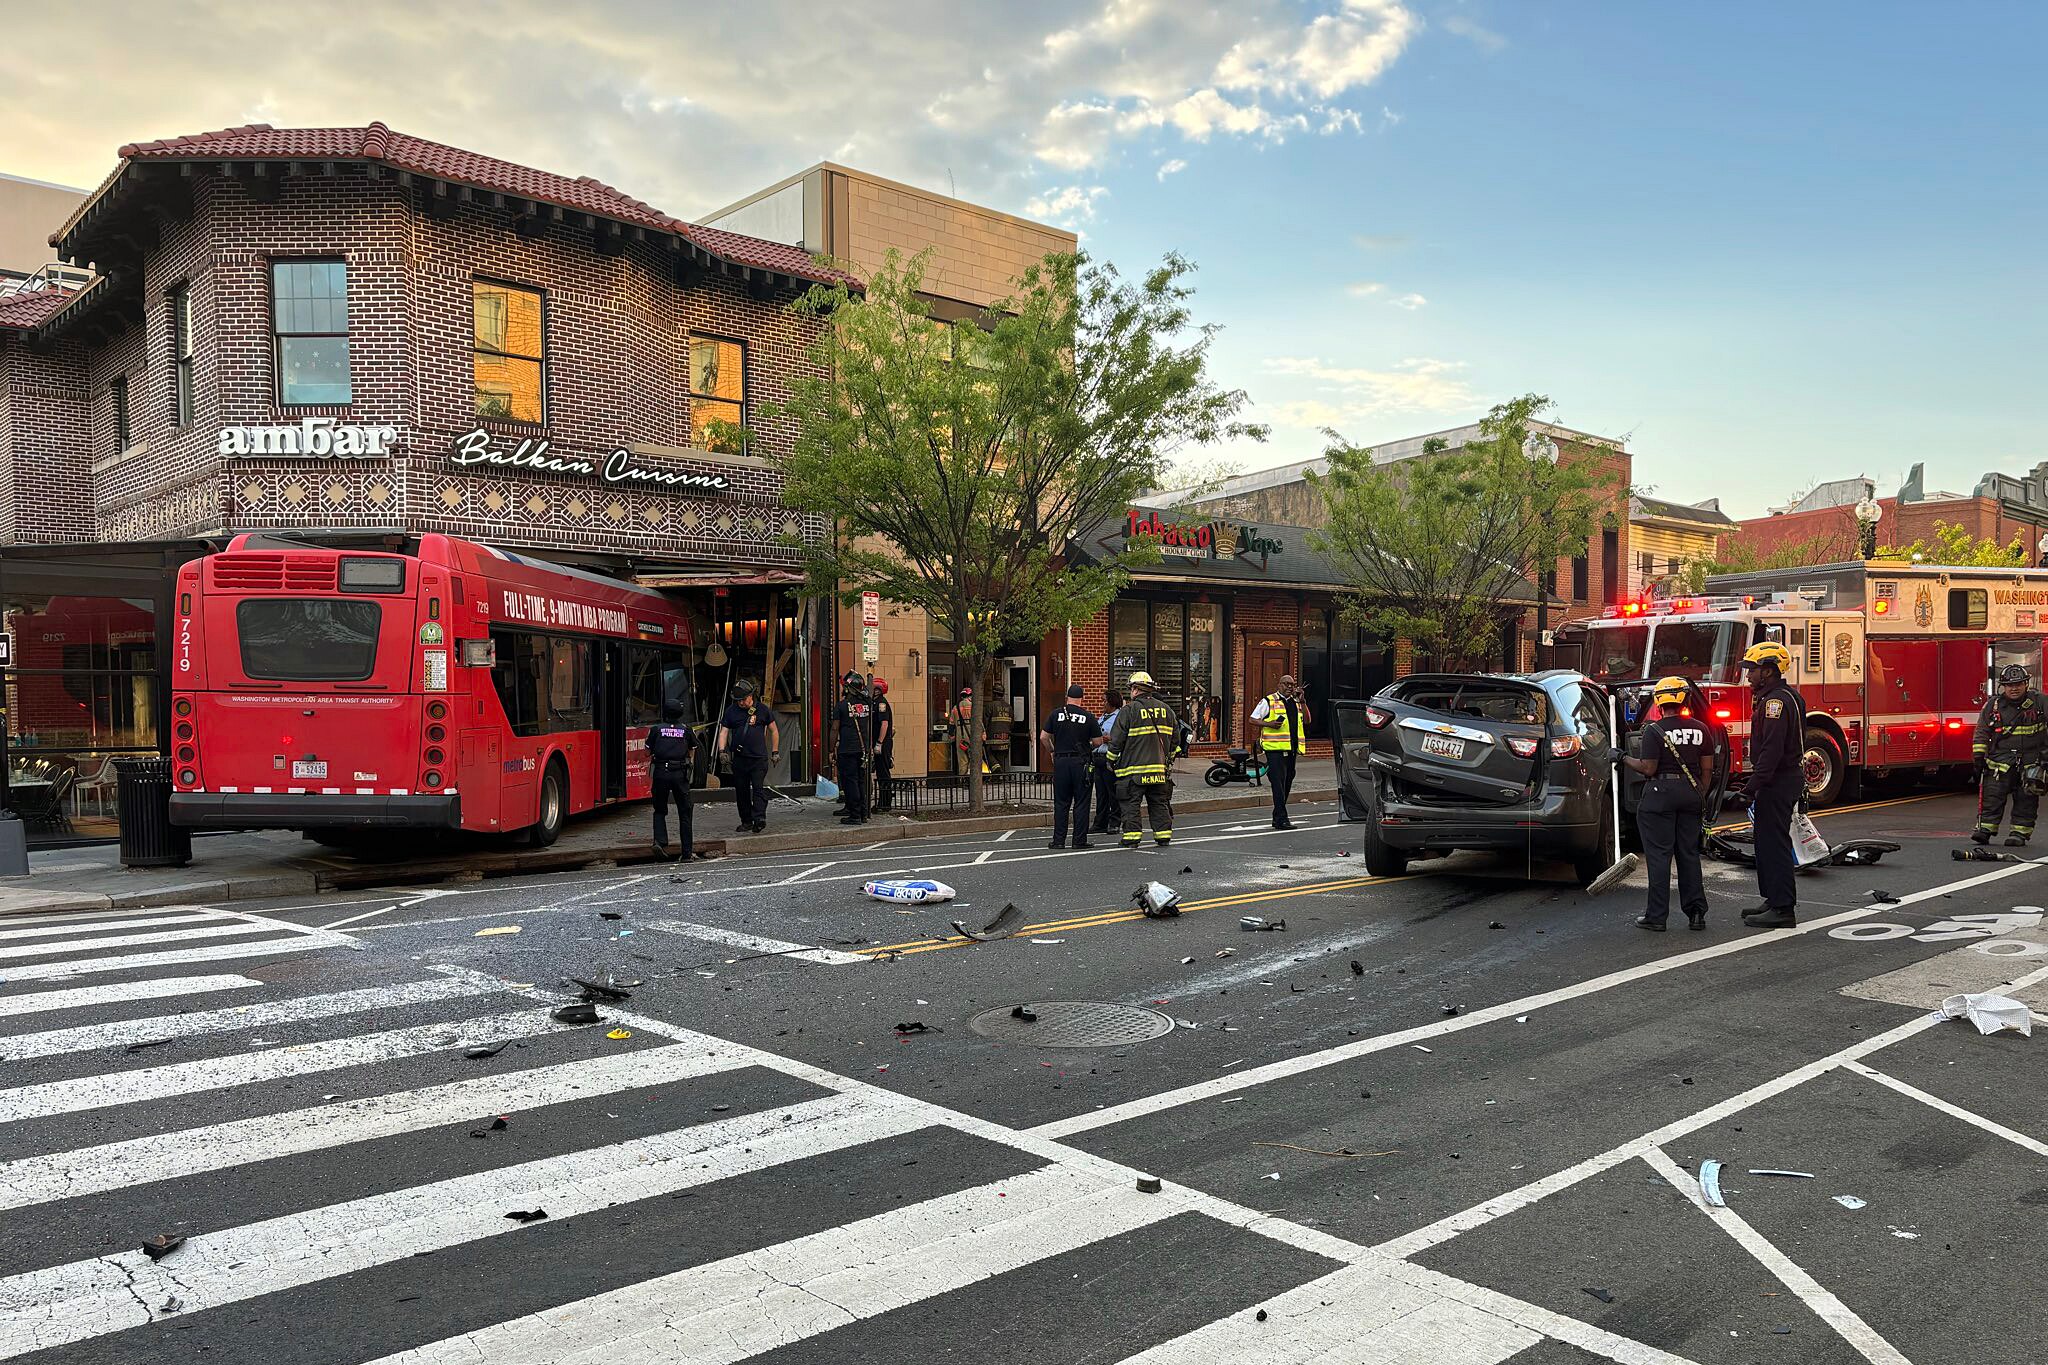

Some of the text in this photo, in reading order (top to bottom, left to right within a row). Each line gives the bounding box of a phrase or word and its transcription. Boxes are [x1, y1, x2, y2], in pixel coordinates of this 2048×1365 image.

[451, 429, 729, 489] Balkan Cuisine
[1126, 509, 1284, 561] Tobacco Vape
[476, 600, 489, 614] 7219
[503, 590, 627, 634] FULL-TIME, 9-MONTH MBA PROGRAM
[180, 618, 191, 672] 7219
[271, 696, 317, 704] METROPOLITAN
[361, 697, 394, 705] AUTHORITY
[503, 755, 536, 774] metrobus
